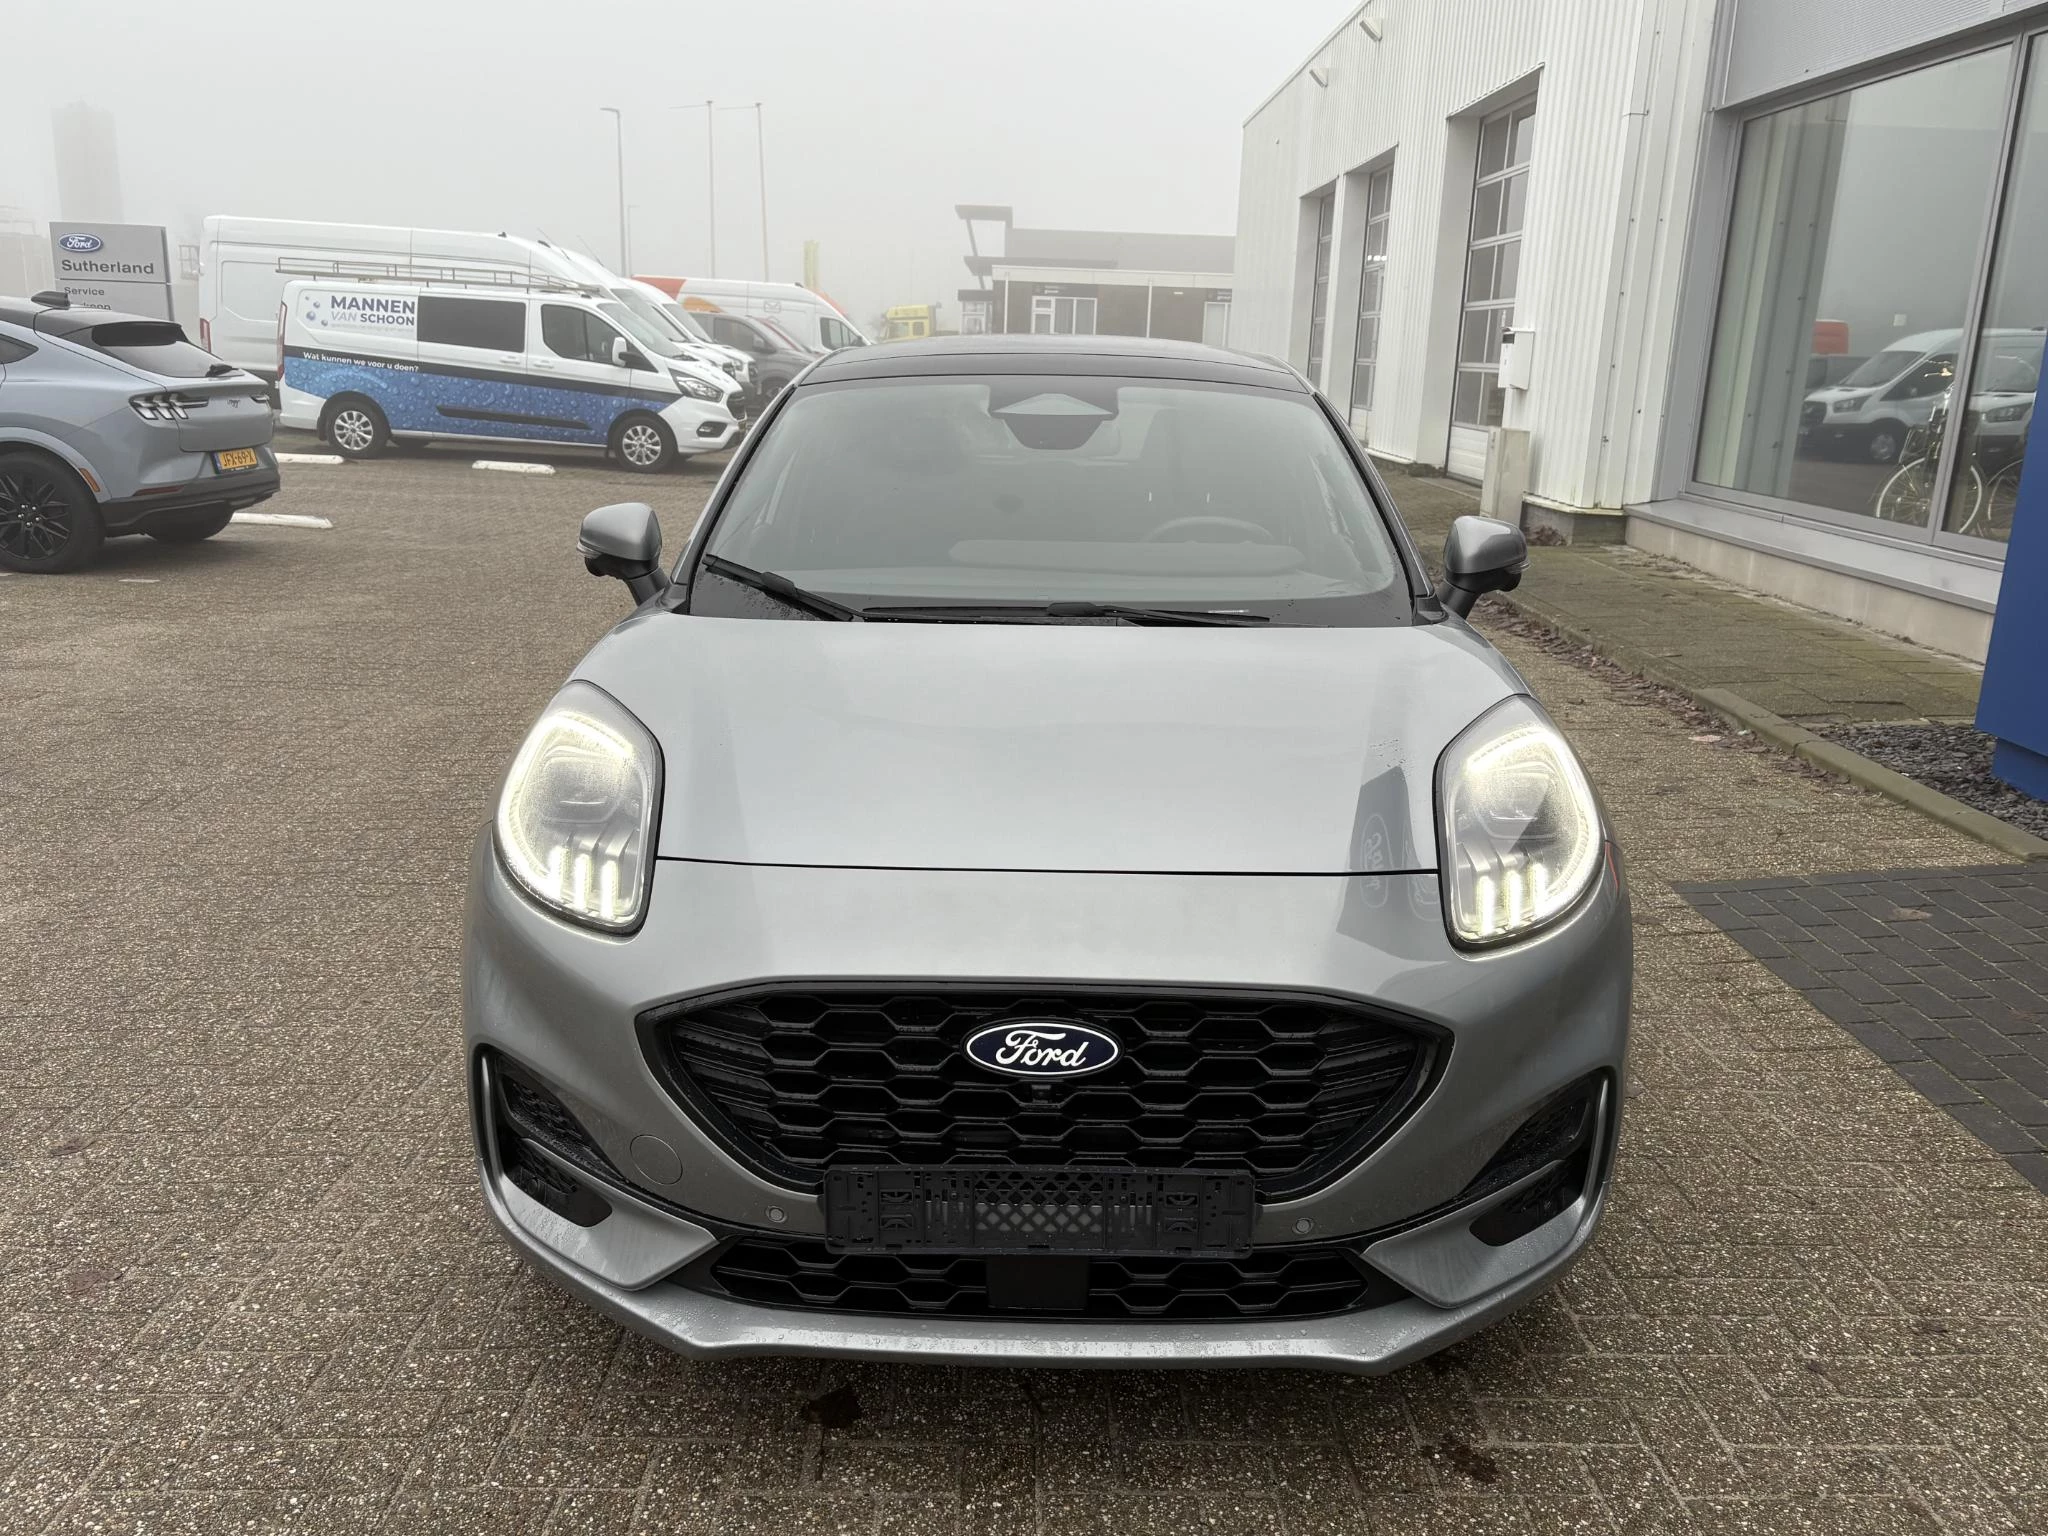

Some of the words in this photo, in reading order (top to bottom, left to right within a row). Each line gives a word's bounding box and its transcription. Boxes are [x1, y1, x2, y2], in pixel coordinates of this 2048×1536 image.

[66, 236, 92, 249] Ford
[61, 259, 154, 275] Sutherland
[64, 286, 105, 296] Service
[331, 295, 415, 314] MANNEN
[331, 311, 357, 322] VAN
[360, 313, 415, 326] SCHOON
[303, 351, 320, 360] Wat
[321, 353, 352, 364] kunnen
[353, 358, 366, 366] we
[367, 360, 385, 369] voor
[394, 362, 419, 372] doen?
[995, 1029, 1089, 1067] Ford
